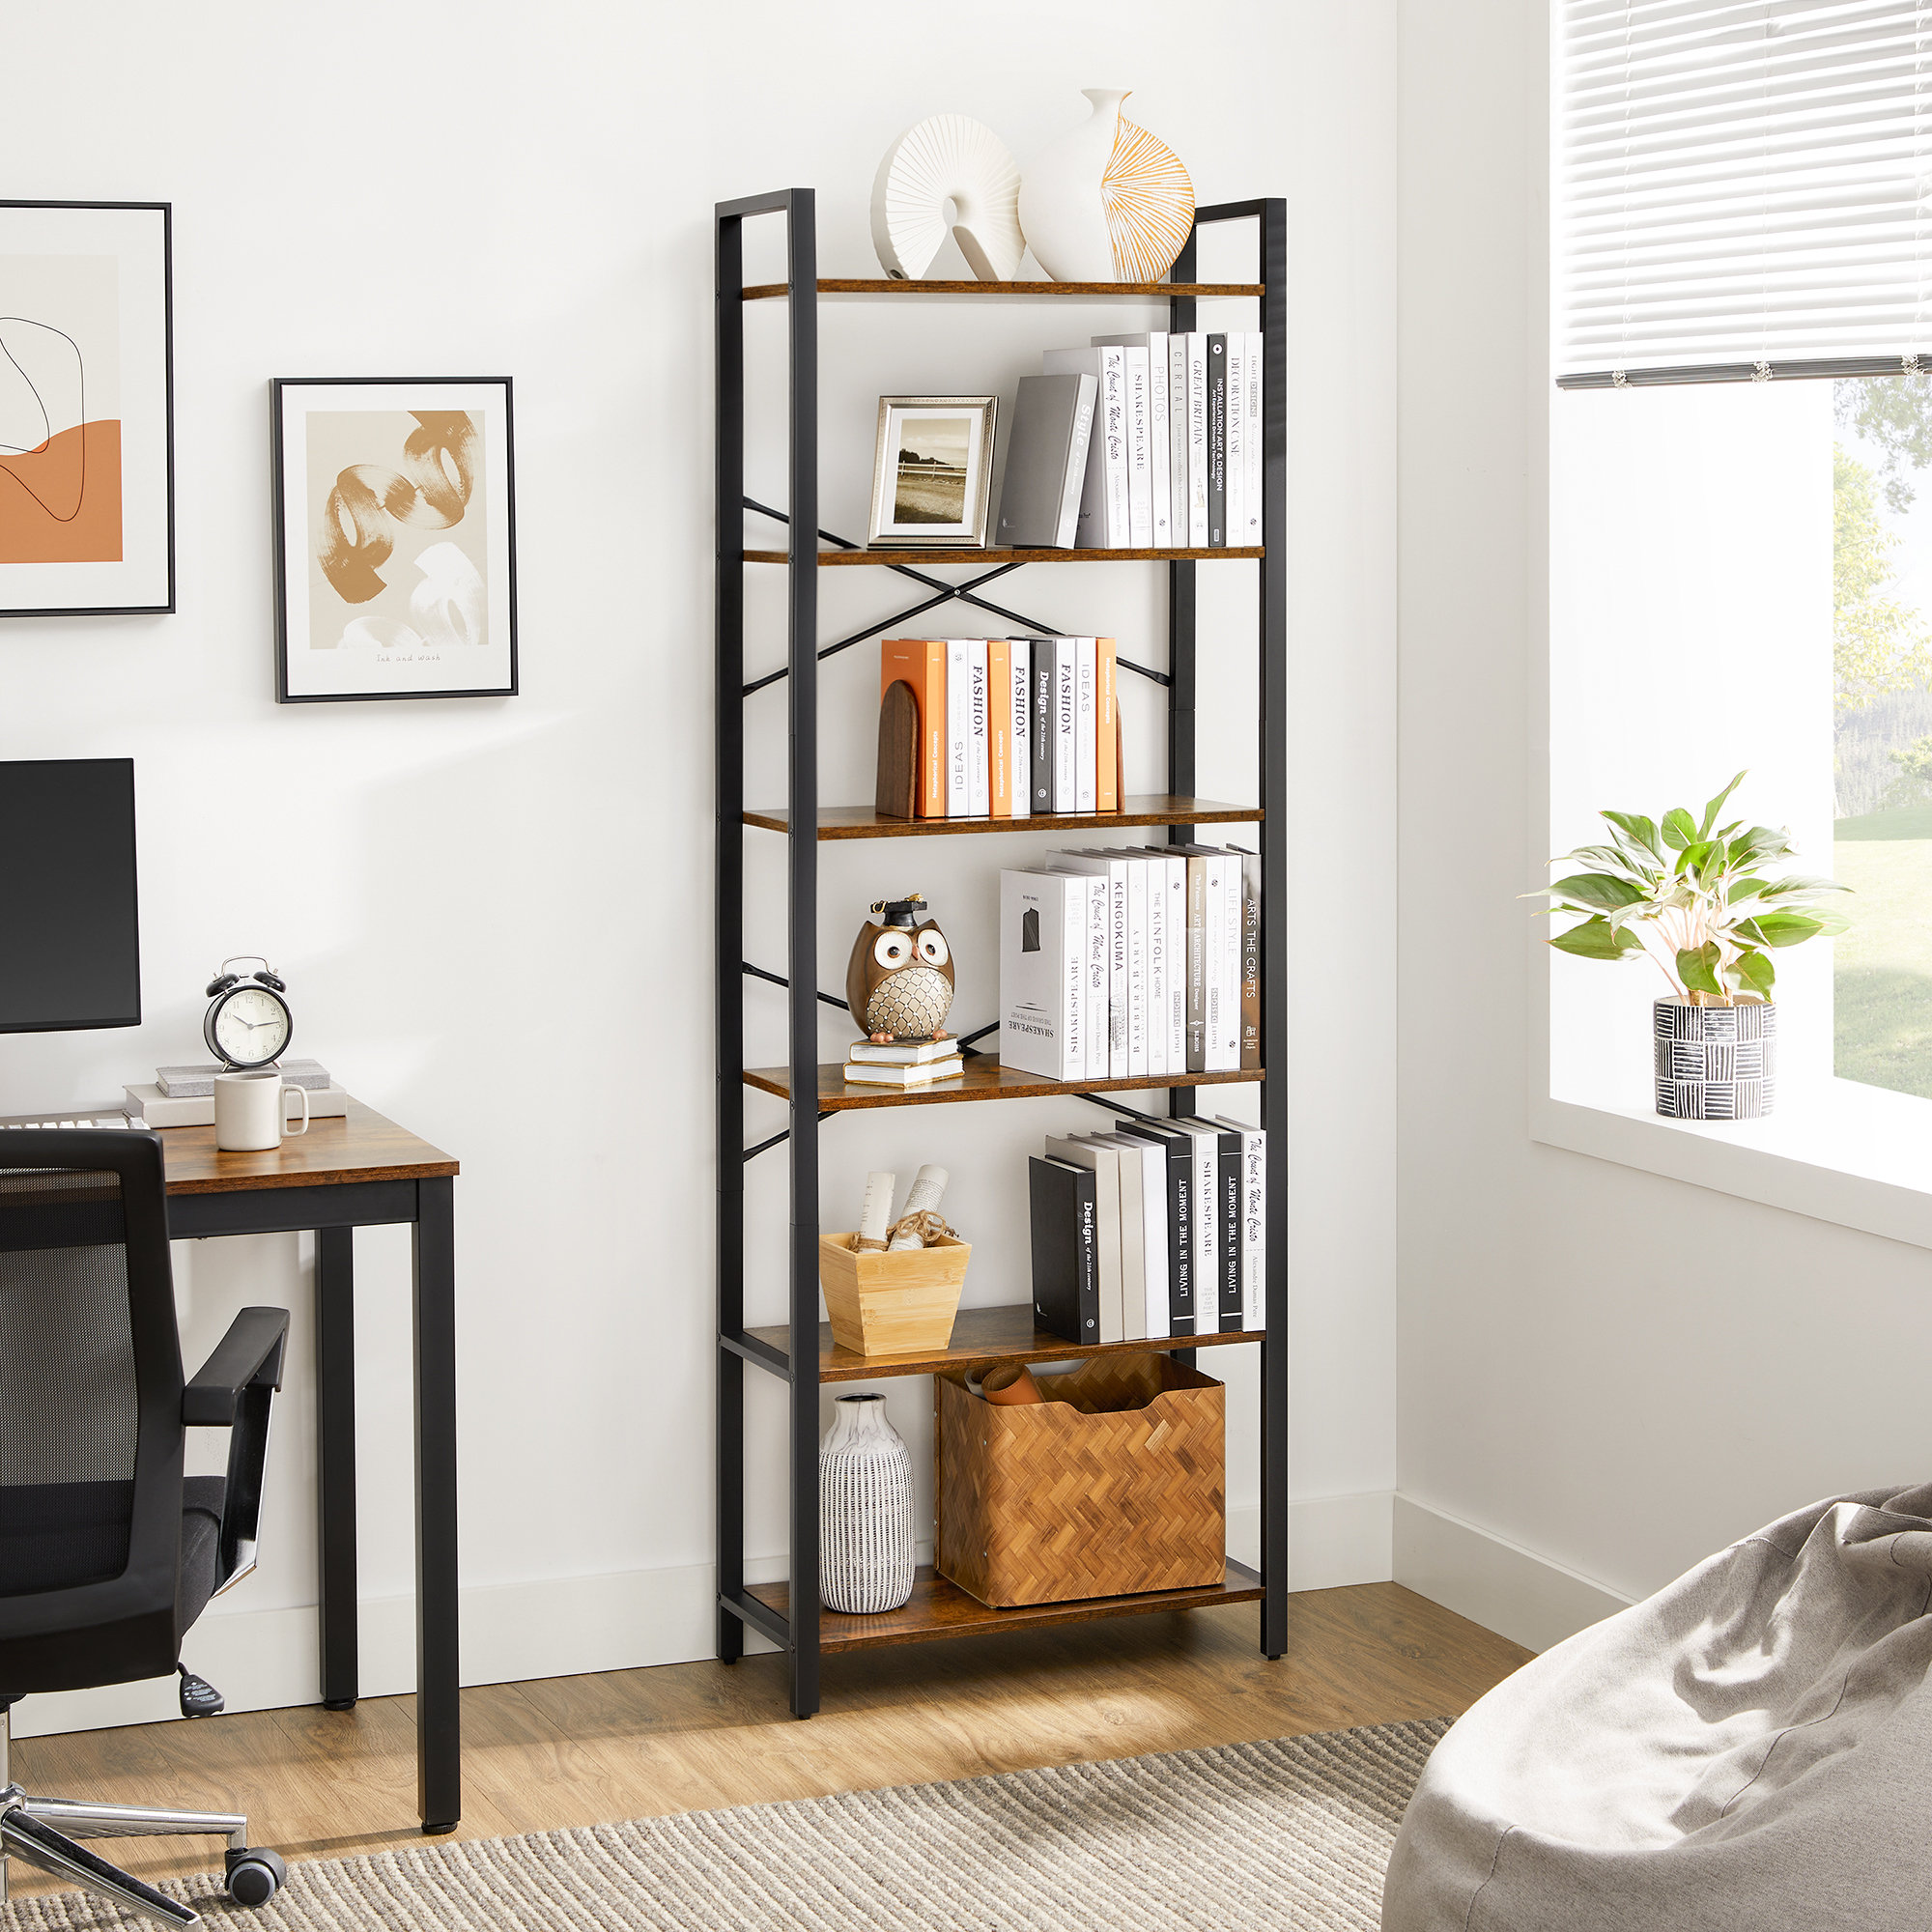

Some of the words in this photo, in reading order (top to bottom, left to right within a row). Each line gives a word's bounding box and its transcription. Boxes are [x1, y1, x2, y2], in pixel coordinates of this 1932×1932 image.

[1108, 355, 1121, 368] The
[1107, 371, 1121, 393] Count
[1154, 366, 1166, 422] PHOTOS
[1174, 351, 1183, 413] CEREAL
[1193, 360, 1203, 399] GREAT
[1231, 357, 1240, 428] DECORATION
[1075, 405, 1092, 446] Style
[1110, 407, 1122, 433] Monte
[1134, 374, 1145, 471] SHAKESPEARE
[1193, 400, 1203, 445] BRITAIN
[1108, 436, 1122, 460] Cristo
[1231, 430, 1240, 457] CASE
[377, 654, 392, 663] Ink
[396, 654, 413, 663] and
[417, 653, 441, 662] wash
[973, 665, 983, 737] FASHION
[1015, 667, 1026, 738] FASHION
[1037, 670, 1049, 715] Design
[1062, 664, 1071, 734] FASHION
[1081, 664, 1091, 713] IDEAS
[954, 741, 964, 790] IDEAS
[1093, 883, 1106, 896] The
[1228, 888, 1237, 915] LIFE
[1092, 898, 1106, 921] Count
[1114, 881, 1123, 971] KENGOKUMA
[1246, 898, 1257, 927] ARTS
[1092, 935, 1105, 961] Monte
[1153, 912, 1162, 975] KINFOLK
[1227, 918, 1237, 955] STYLE
[1246, 930, 1257, 953] THE
[1091, 964, 1105, 988] Cristo
[1193, 933, 1202, 987] ARCHITECTURE
[1153, 977, 1162, 1000] HOME
[1246, 957, 1257, 999] CRAFTS
[233, 1001, 239, 1009] 11
[261, 998, 265, 1007] 1
[270, 1008, 276, 1016] 2
[1069, 955, 1079, 1054] SHAKESPEARE
[1173, 991, 1181, 1028] DESIGNS
[1210, 988, 1219, 1024] DESIGNS
[1008, 1020, 1055, 1039] SHAKESPEARE
[1250, 1138, 1263, 1151] The
[1247, 1153, 1263, 1176] Count
[1179, 1179, 1188, 1222] MOMENT
[1204, 1161, 1212, 1257] SHAKESPEARE
[1228, 1176, 1236, 1219] MOMENT
[1249, 1189, 1262, 1215] Monte
[1083, 1201, 1094, 1245] Design
[1179, 1226, 1188, 1246] THE
[1228, 1222, 1236, 1243] THE
[1247, 1218, 1262, 1242] Cristo
[1179, 1250, 1188, 1260] IN
[1228, 1246, 1236, 1257] IN
[1179, 1264, 1189, 1297] LIVING
[1228, 1261, 1237, 1294] LIVING
